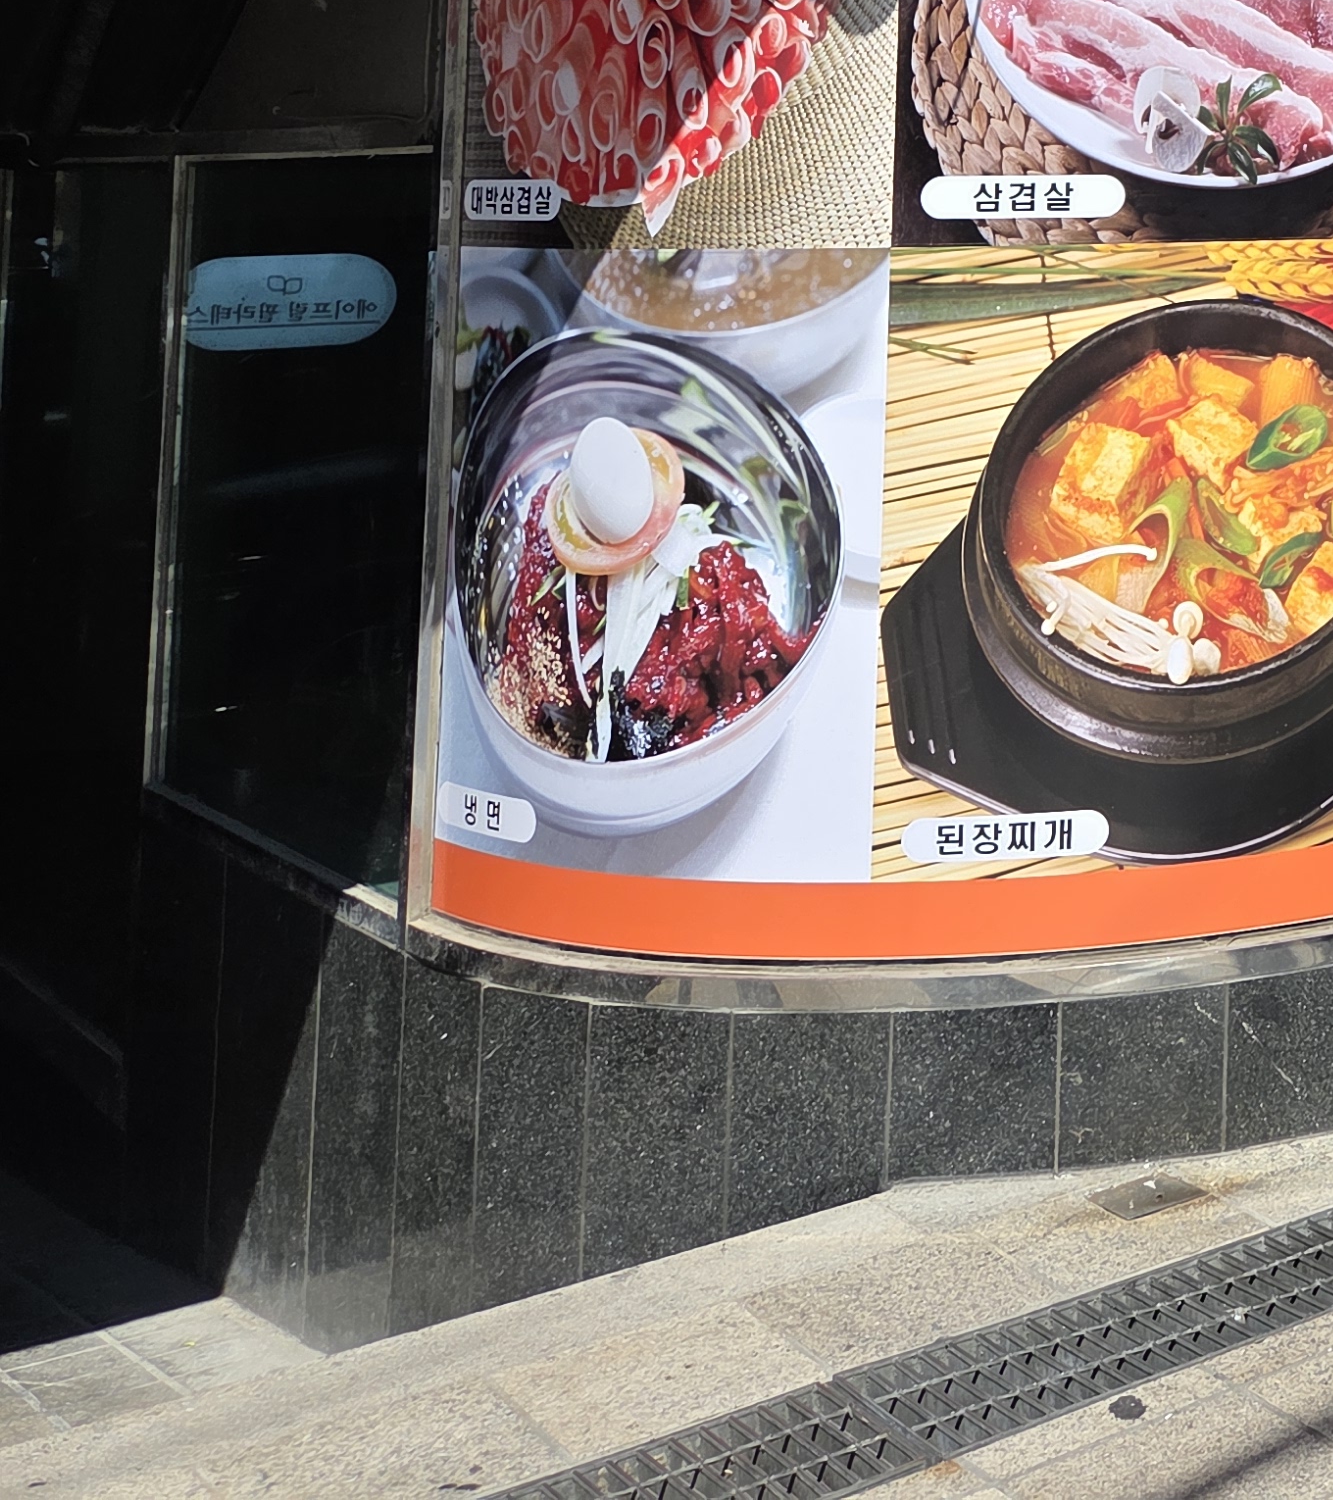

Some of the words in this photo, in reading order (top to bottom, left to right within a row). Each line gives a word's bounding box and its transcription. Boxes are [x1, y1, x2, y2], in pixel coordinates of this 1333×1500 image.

[470, 183, 554, 216] 대박삼겹살
[972, 181, 1076, 213] 삼겹살
[462, 792, 502, 832] 냉면
[935, 817, 1076, 856] 된장찌개
